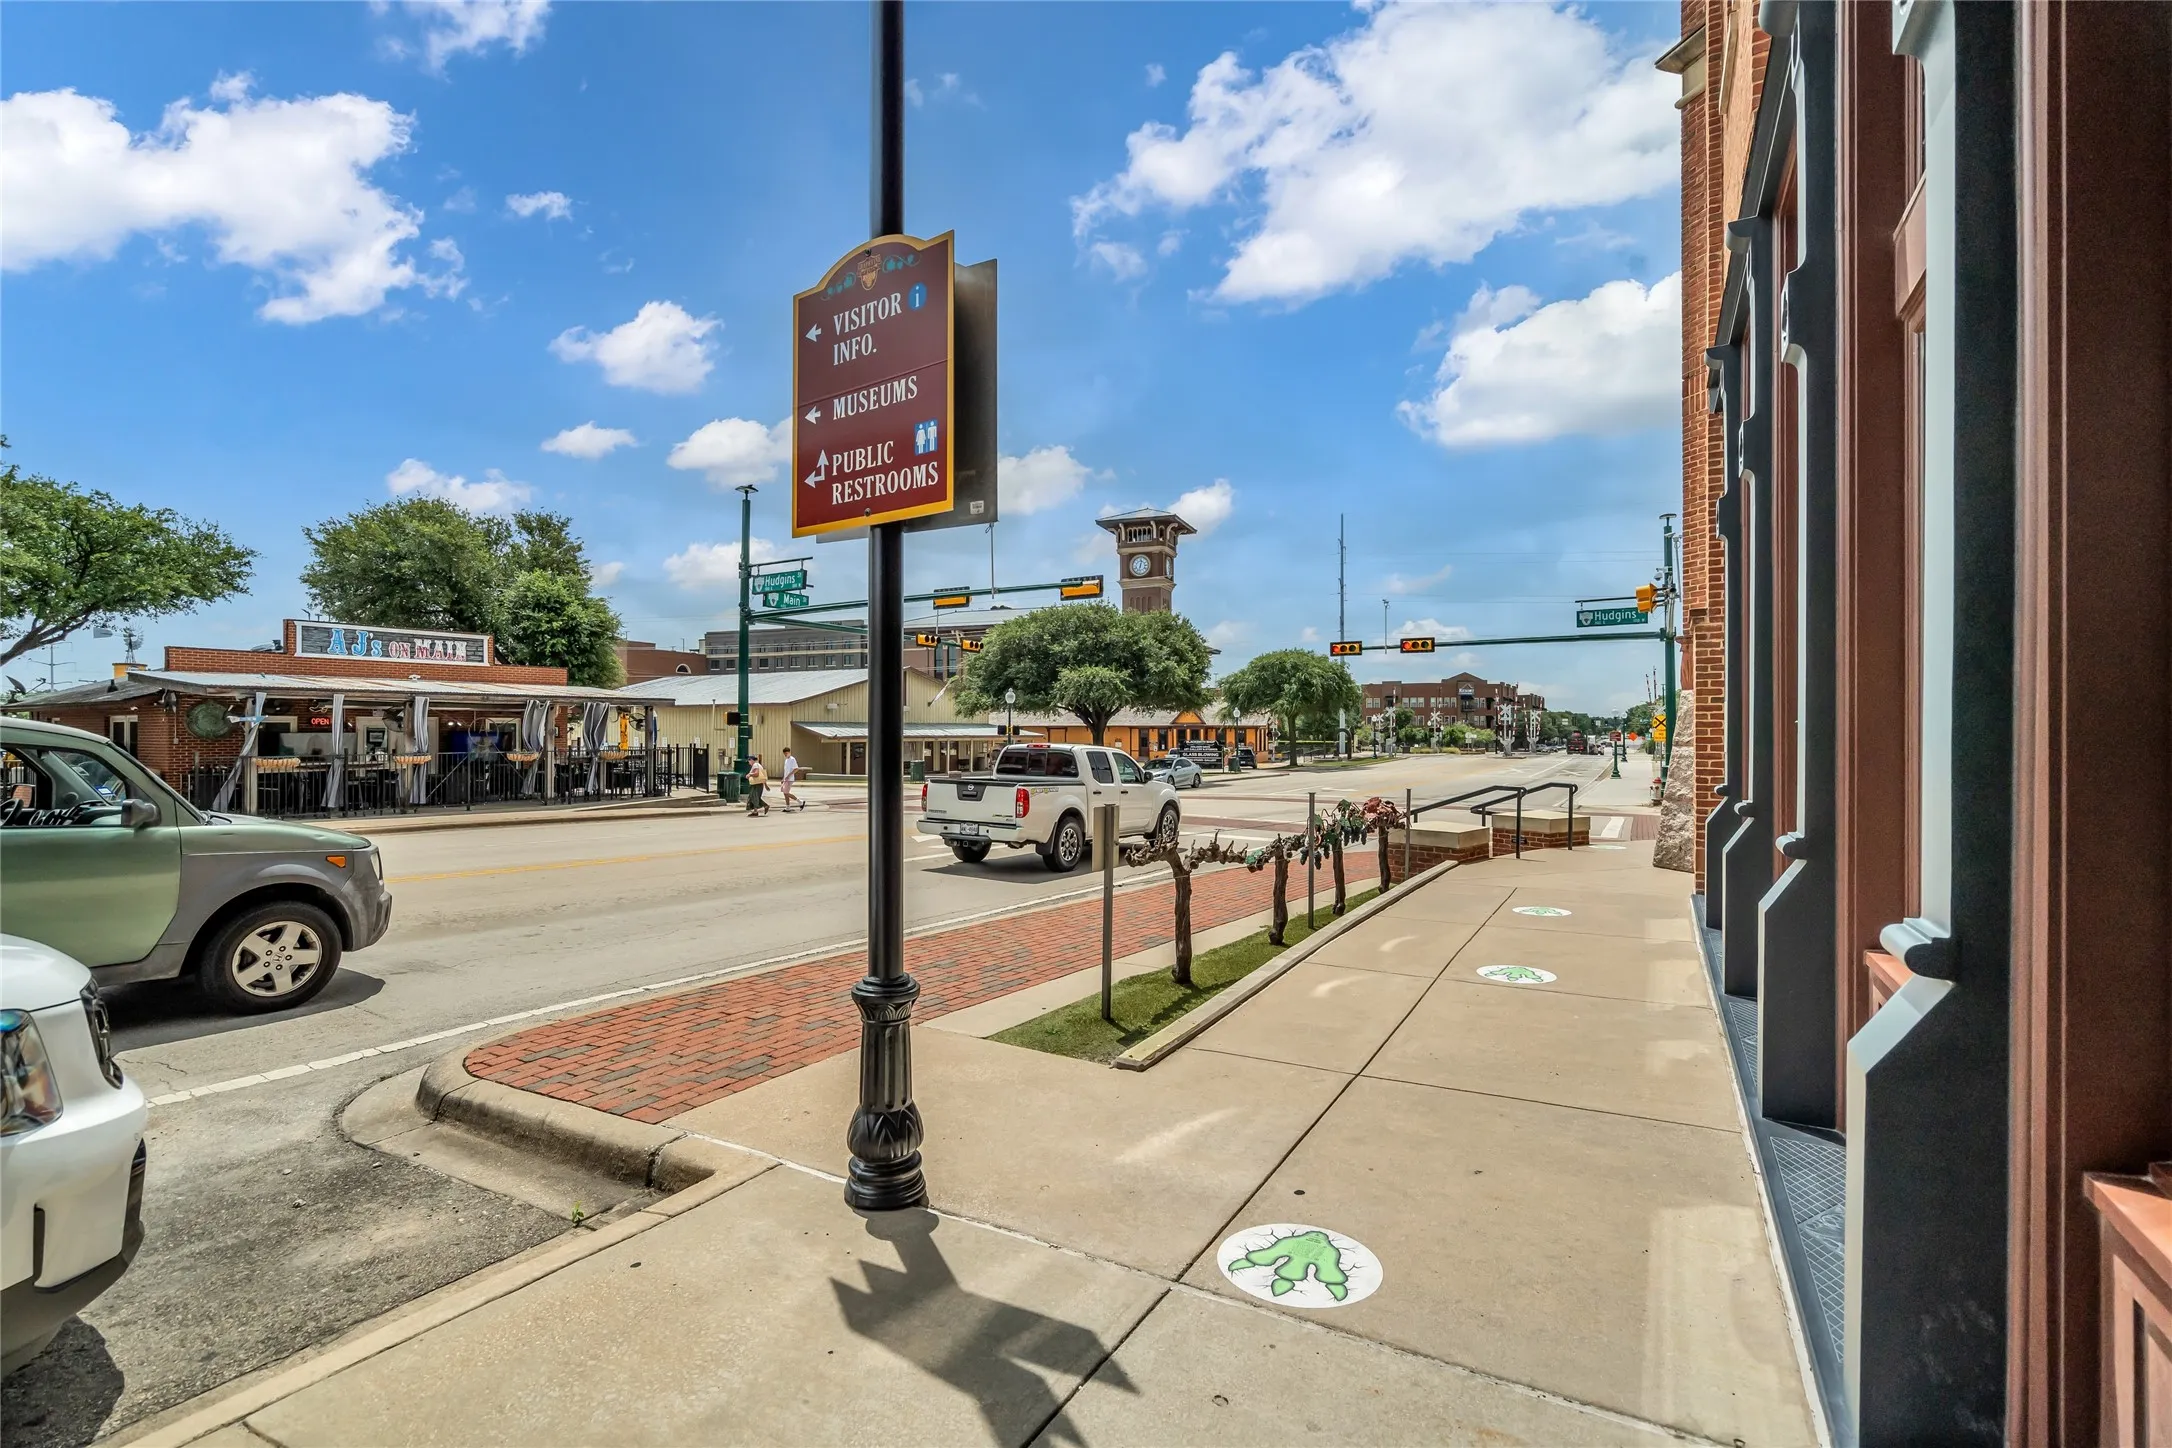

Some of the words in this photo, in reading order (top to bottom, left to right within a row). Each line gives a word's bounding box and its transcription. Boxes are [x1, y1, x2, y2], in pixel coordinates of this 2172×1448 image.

[833, 292, 902, 336] VISITOR
[833, 333, 877, 366] INFO.
[832, 375, 918, 420] MUSEUMS
[832, 440, 894, 476] PUBLIC
[832, 461, 939, 505] RESTROOMS
[764, 573, 796, 588] Hudgins
[783, 593, 801, 606] Main
[1594, 609, 1637, 622] Hudgins
[327, 628, 383, 658] AJ's
[388, 641, 411, 659] ON
[413, 638, 467, 662] MAIN
[311, 717, 330, 725] OPEN
